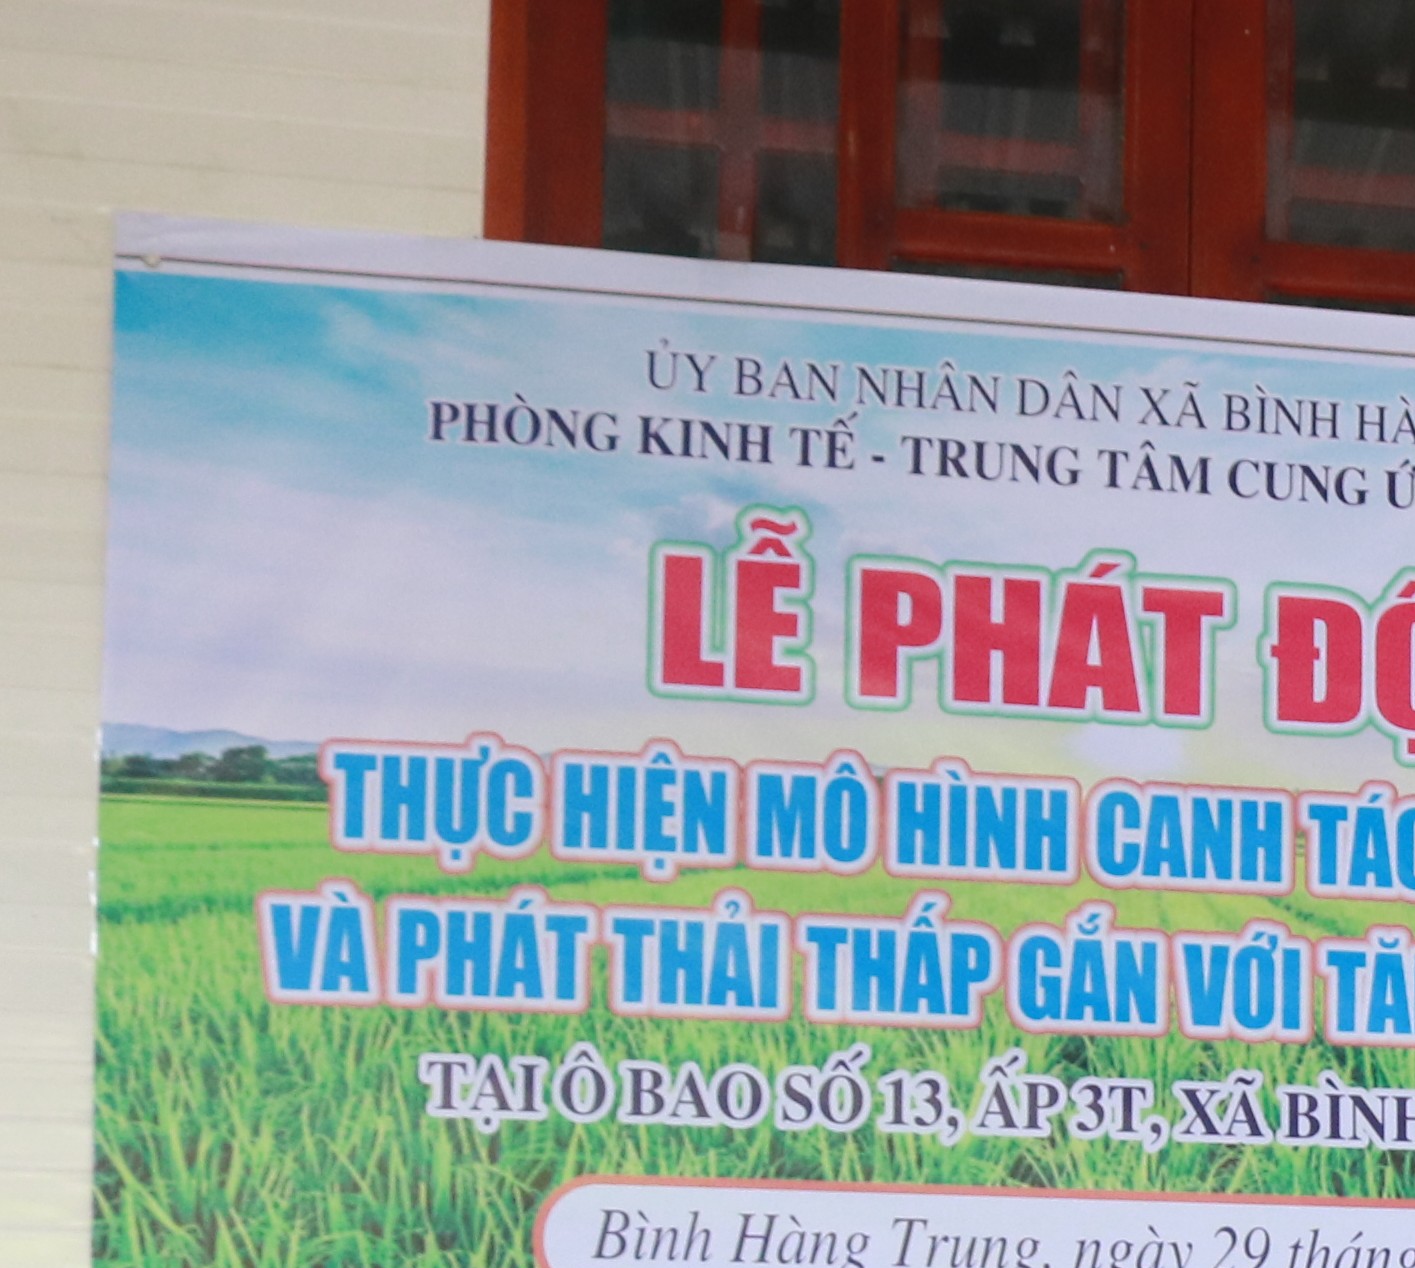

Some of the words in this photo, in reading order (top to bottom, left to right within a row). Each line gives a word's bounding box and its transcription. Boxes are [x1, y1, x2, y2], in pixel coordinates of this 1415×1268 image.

[645, 337, 716, 393] ỦY
[734, 357, 841, 403] BAN
[856, 360, 1000, 414] NHÂN
[1015, 368, 1122, 424] DÂN
[1138, 380, 1207, 430] XÃ
[1222, 386, 1340, 440] BÌNH
[427, 393, 620, 454] PHÒNG
[637, 416, 773, 465] KINH
[789, 410, 861, 471] TẾ
[900, 436, 1082, 487] TRUNG
[1098, 440, 1212, 497] TÂM
[1227, 458, 1369, 508] CUNG
[659, 516, 802, 695] LỄ
[856, 561, 1224, 718] PHÁT
[332, 745, 536, 860] THỰC
[561, 751, 727, 870] HIỆN
[755, 759, 869, 864] MÔ
[896, 768, 1068, 873] HÌNH
[1096, 792, 1284, 884] CANH
[269, 890, 371, 994] VÀ
[400, 899, 589, 1002] PHÁT
[611, 899, 781, 1009] THẢI
[805, 901, 989, 1018] THẤP
[1016, 910, 1158, 1025] GẮN
[1182, 929, 1302, 1031] VỚI
[426, 1060, 543, 1127] TẠI
[560, 1051, 606, 1116] Ô
[627, 1068, 763, 1122] BAO
[781, 1051, 867, 1125] SỐ
[884, 1078, 959, 1139] 13,
[976, 1057, 1063, 1131] ẤP
[1076, 1083, 1163, 1146] 3T,
[1181, 1077, 1266, 1138] XÃ
[592, 1208, 712, 1262] Bình
